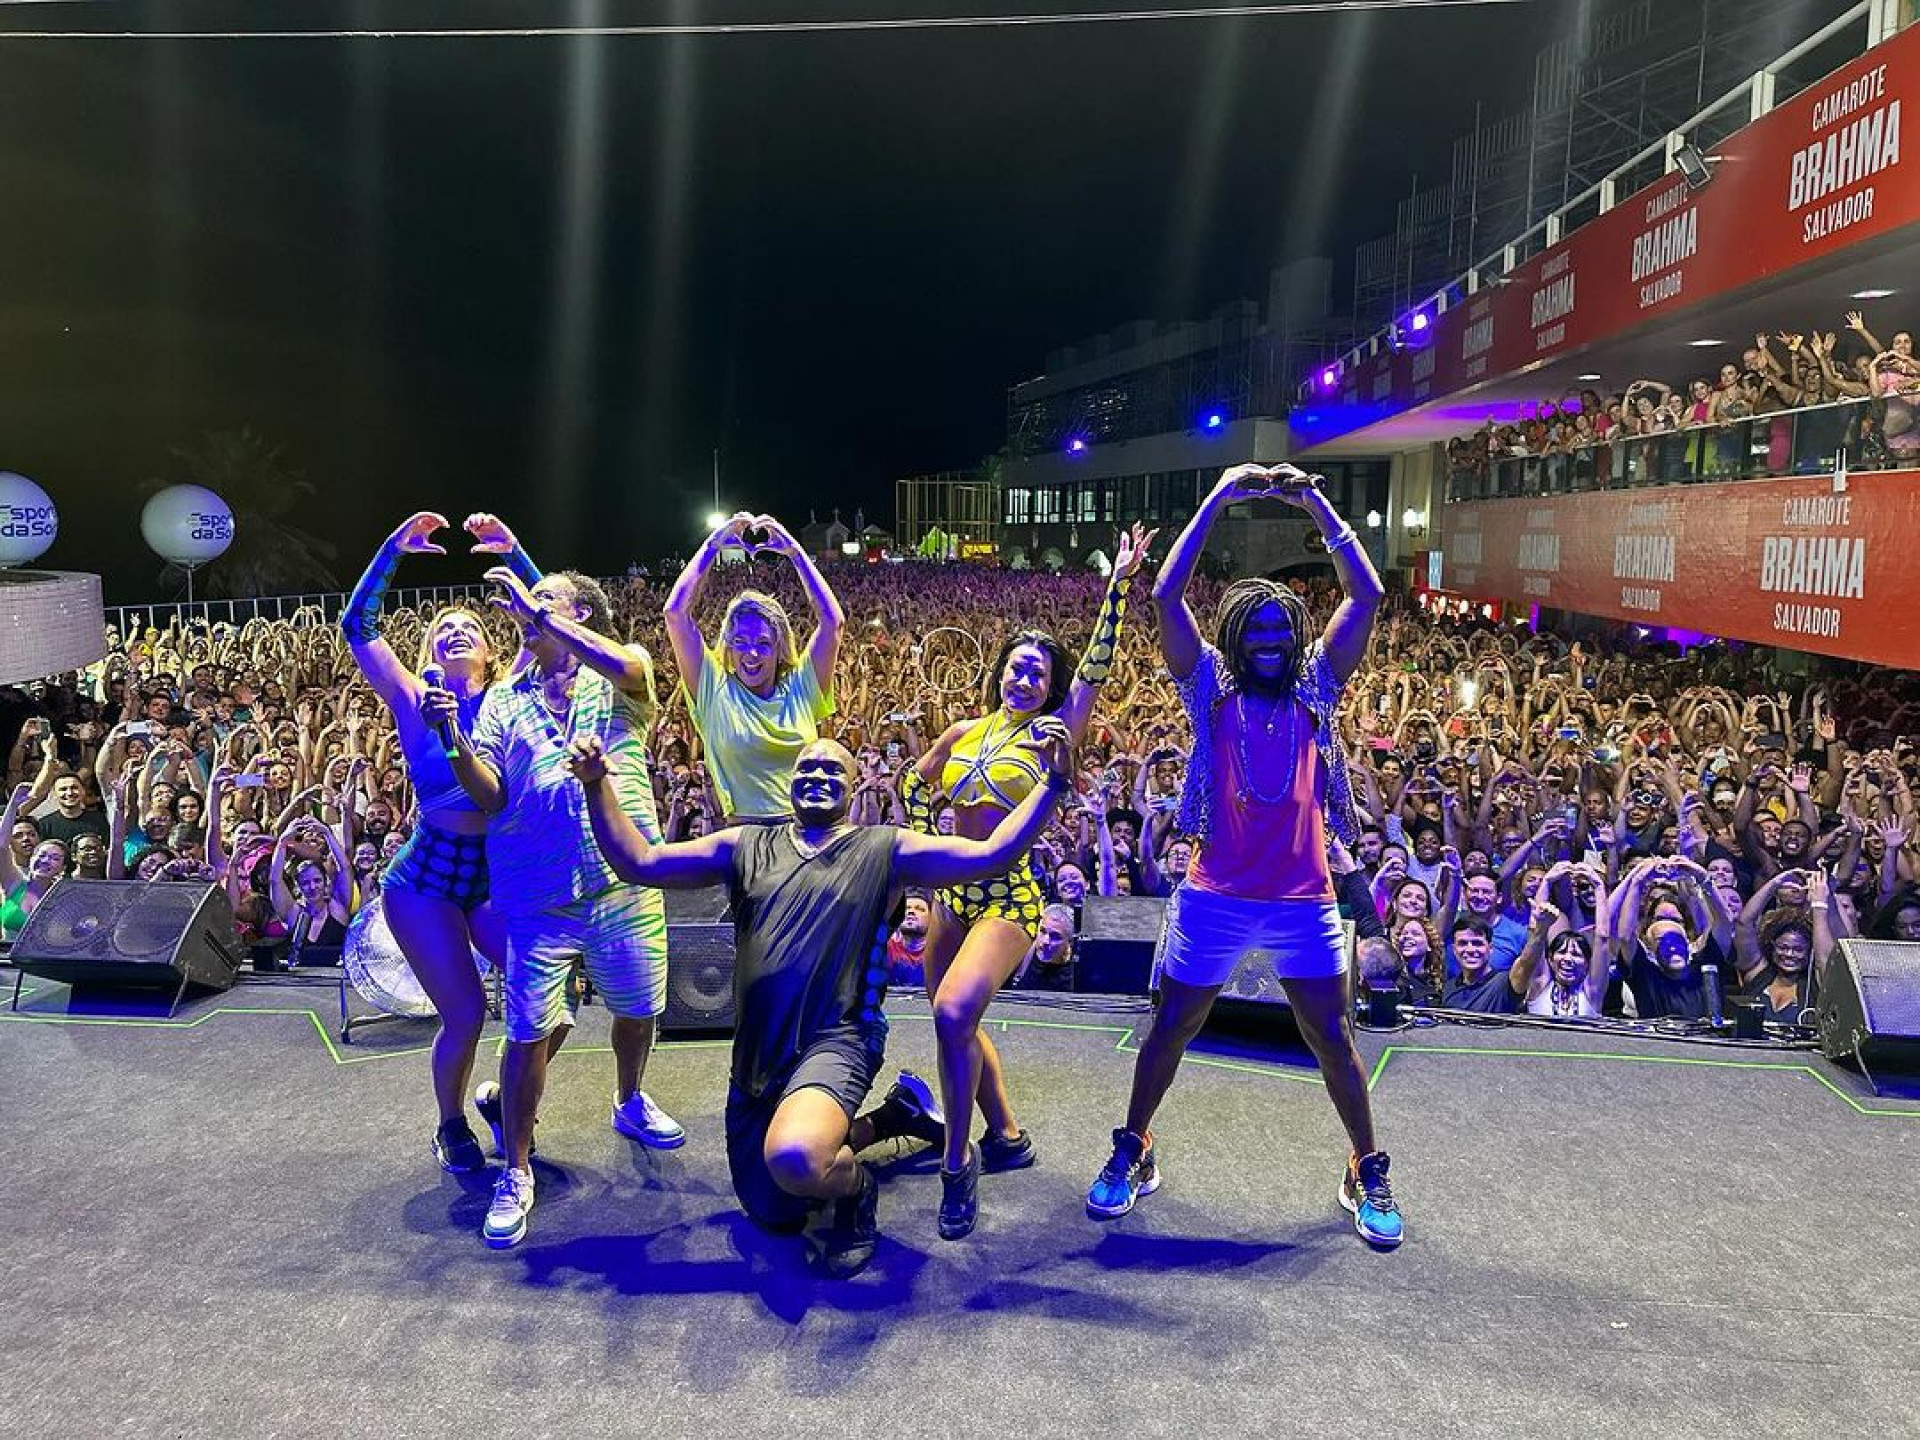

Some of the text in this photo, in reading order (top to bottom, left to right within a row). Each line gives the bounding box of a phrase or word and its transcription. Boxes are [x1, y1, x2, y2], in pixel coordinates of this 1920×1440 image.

[1812, 63, 1887, 132] CAMAROTE
[1788, 99, 1901, 211] BRAHMA
[1632, 206, 1697, 282] BRAHMA
[1803, 186, 1875, 243] SALVADOR
[1783, 497, 1852, 526] CAMAROTE
[1614, 536, 1676, 582] BRAHMA
[1760, 537, 1866, 599] BRAHMA
[1774, 602, 1841, 638] SALVADOR
